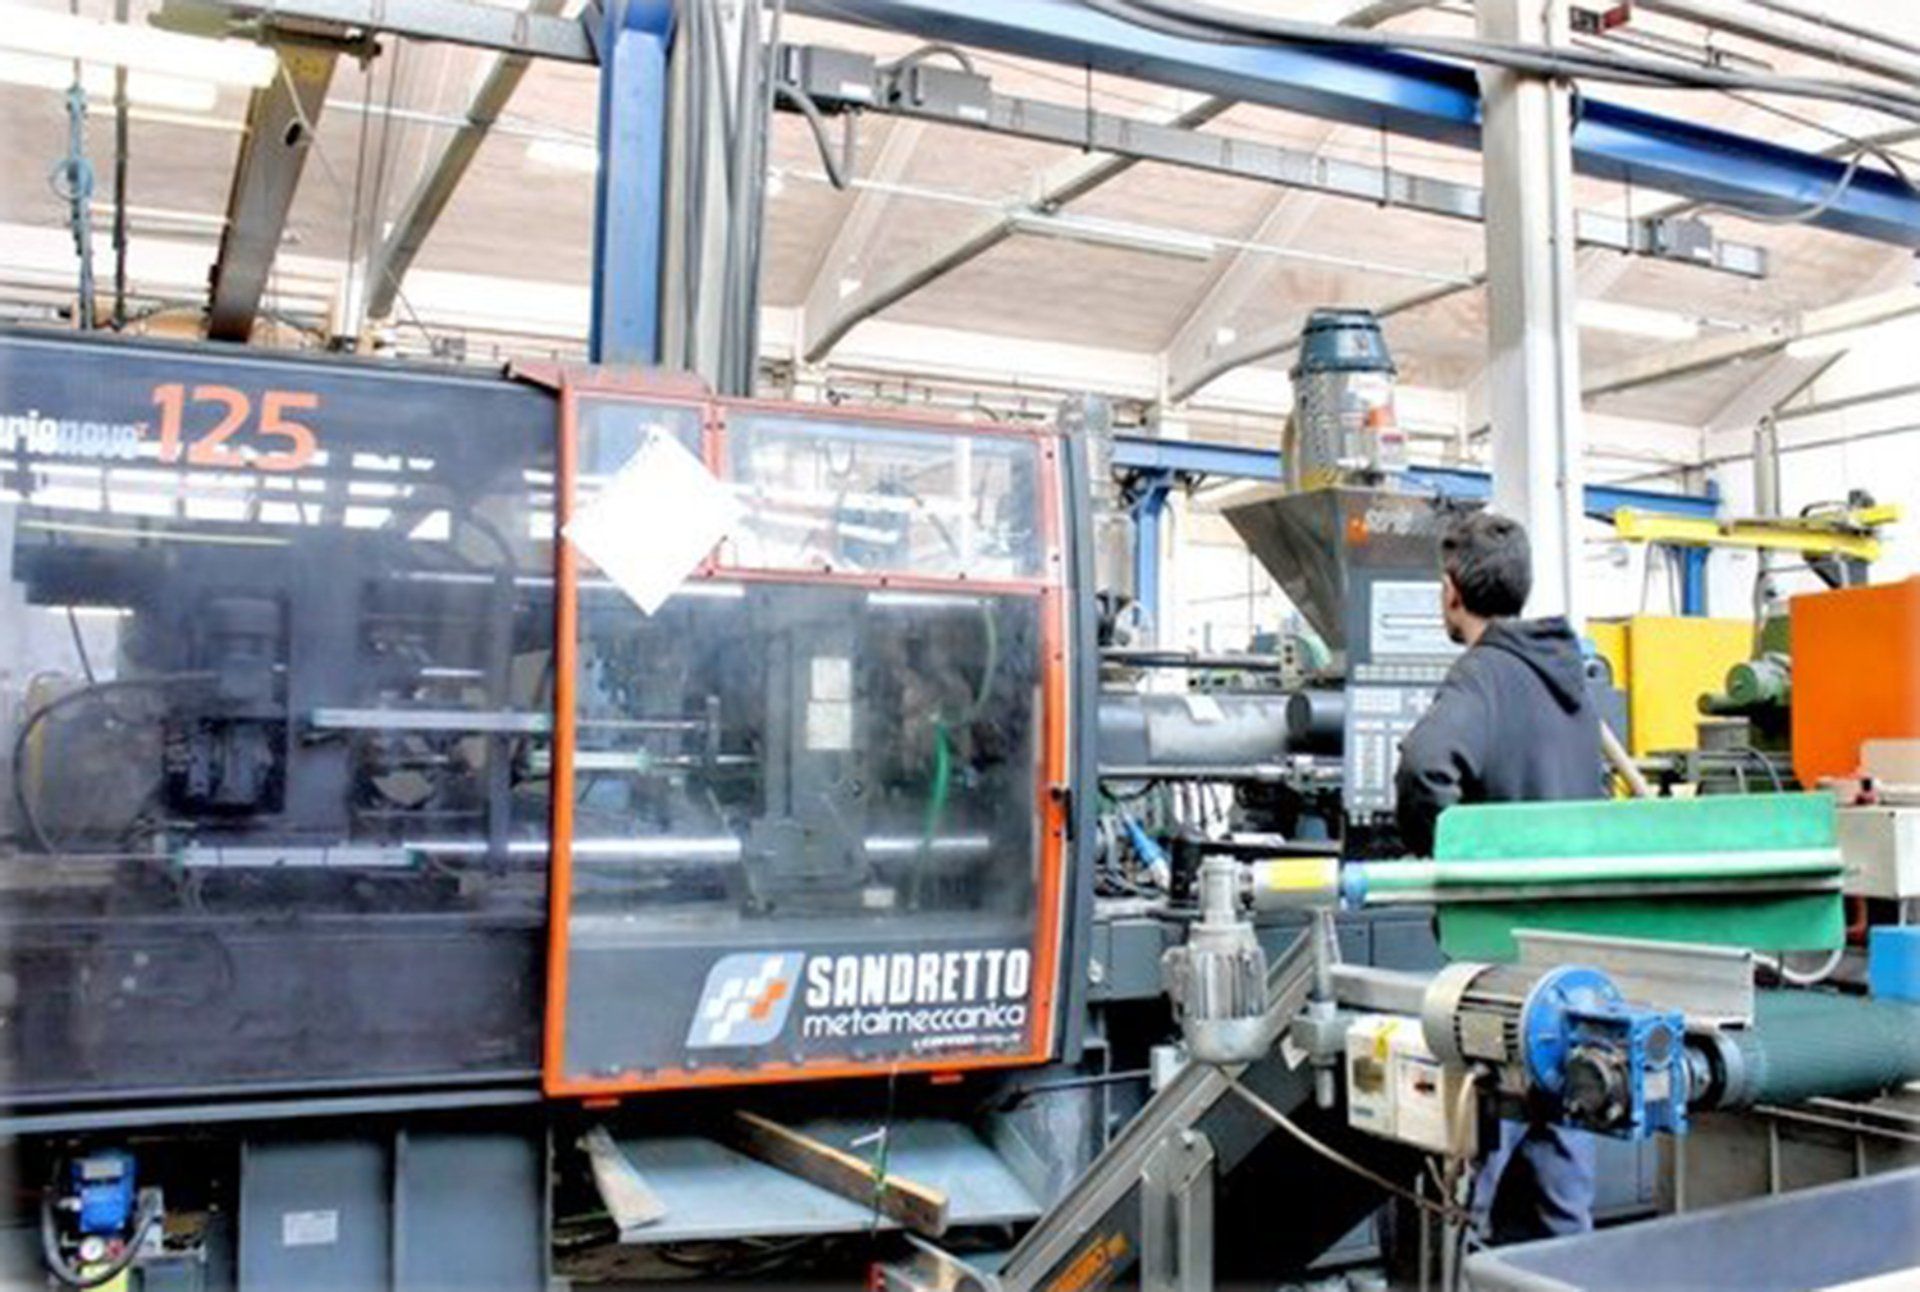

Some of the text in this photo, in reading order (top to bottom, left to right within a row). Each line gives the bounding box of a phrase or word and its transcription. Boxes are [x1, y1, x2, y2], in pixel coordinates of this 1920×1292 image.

[153, 384, 320, 471] 125
[805, 949, 1031, 1008] SANDRETTO
[803, 1002, 1026, 1038] metalmeccanica
